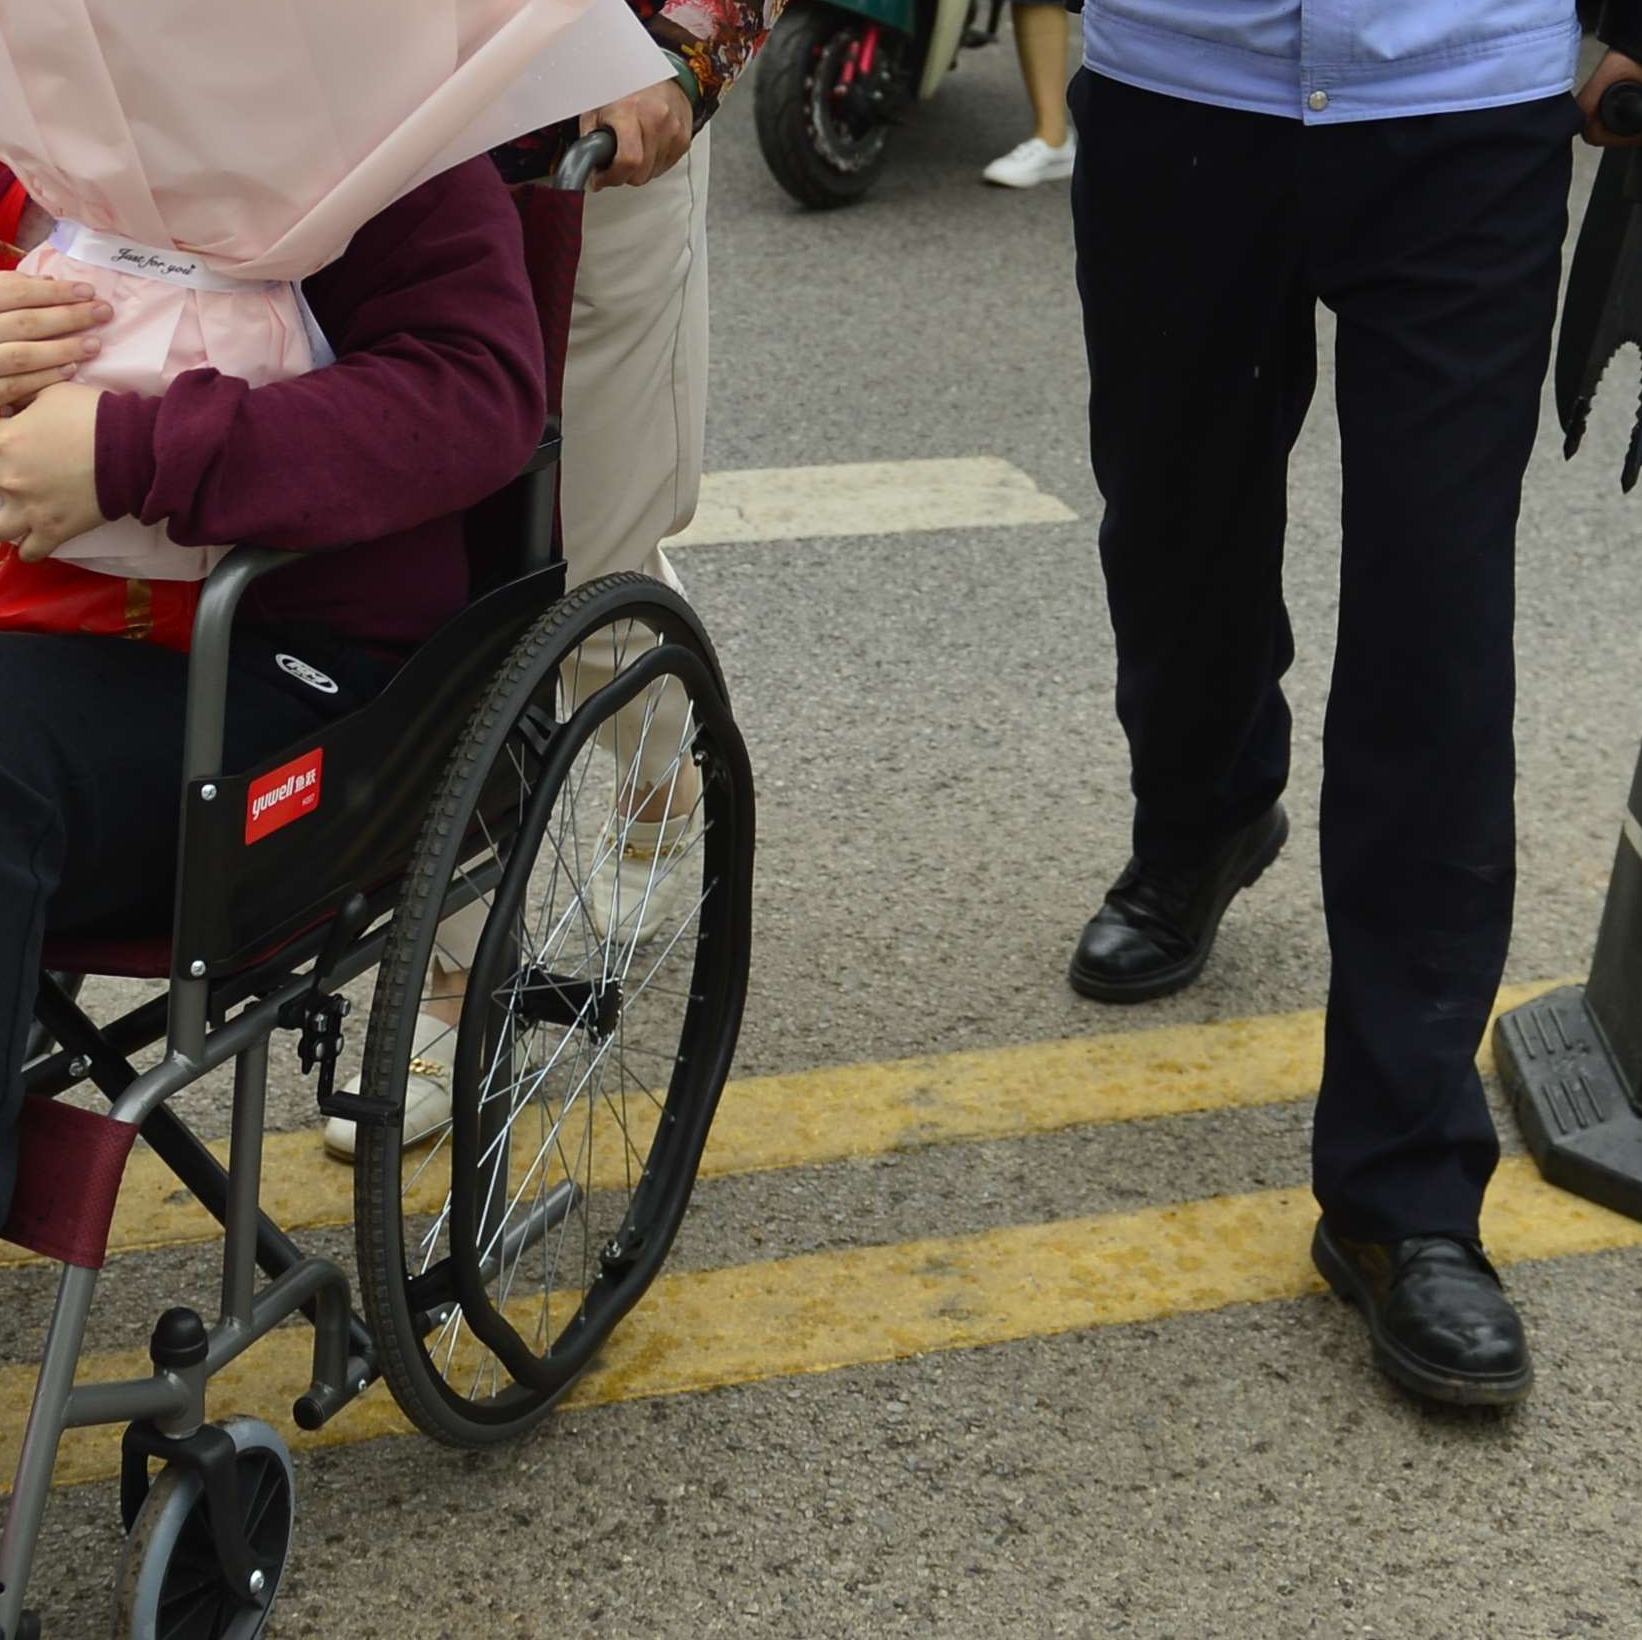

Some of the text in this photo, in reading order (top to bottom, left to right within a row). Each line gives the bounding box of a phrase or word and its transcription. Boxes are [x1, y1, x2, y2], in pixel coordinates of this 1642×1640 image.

[111, 247, 193, 275] Just for you
[252, 774, 295, 821] yuwell
